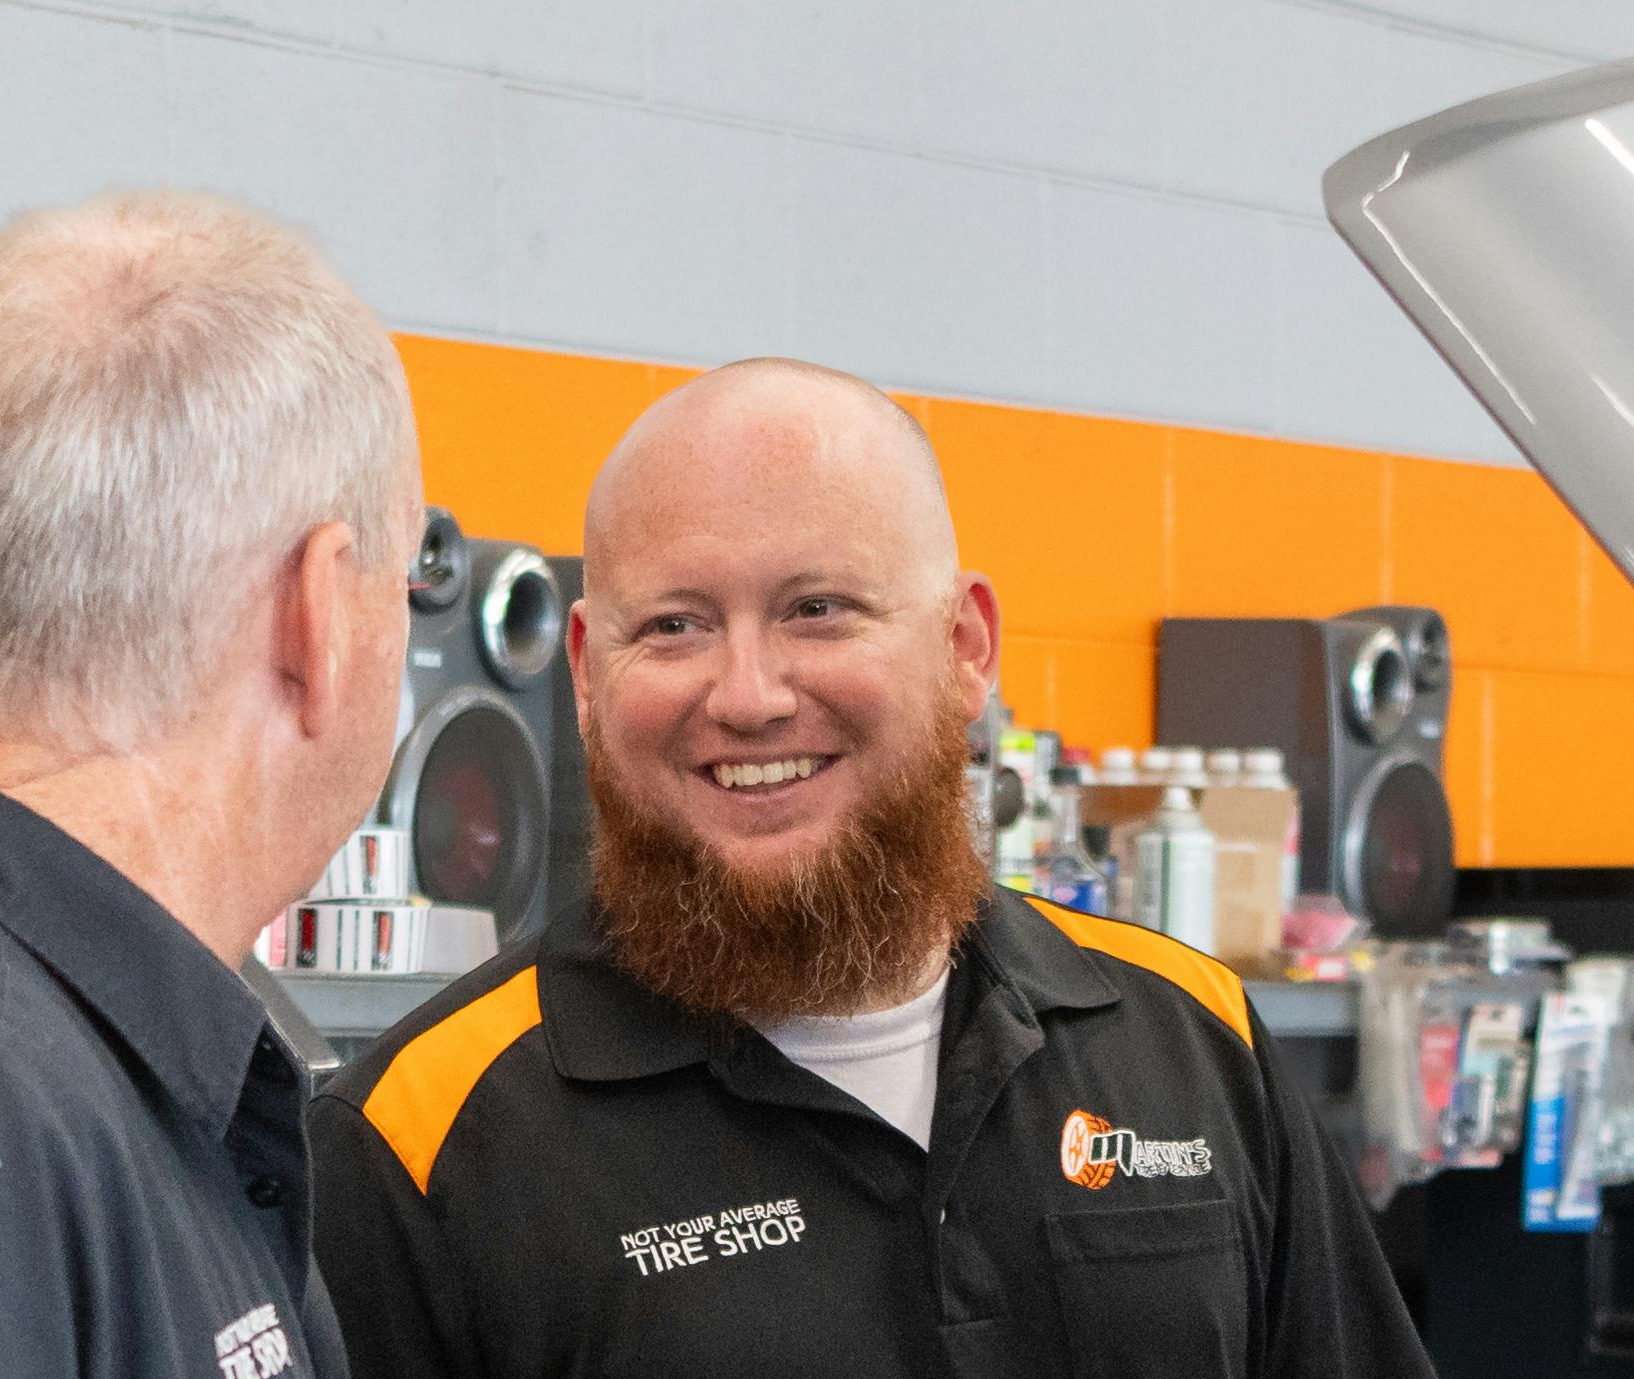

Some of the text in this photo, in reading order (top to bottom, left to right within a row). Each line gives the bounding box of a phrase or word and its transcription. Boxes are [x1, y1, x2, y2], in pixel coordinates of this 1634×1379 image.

[620, 1199, 801, 1250] NOT YOUR AVERAGE
[625, 1216, 806, 1276] TIRE SHOP
